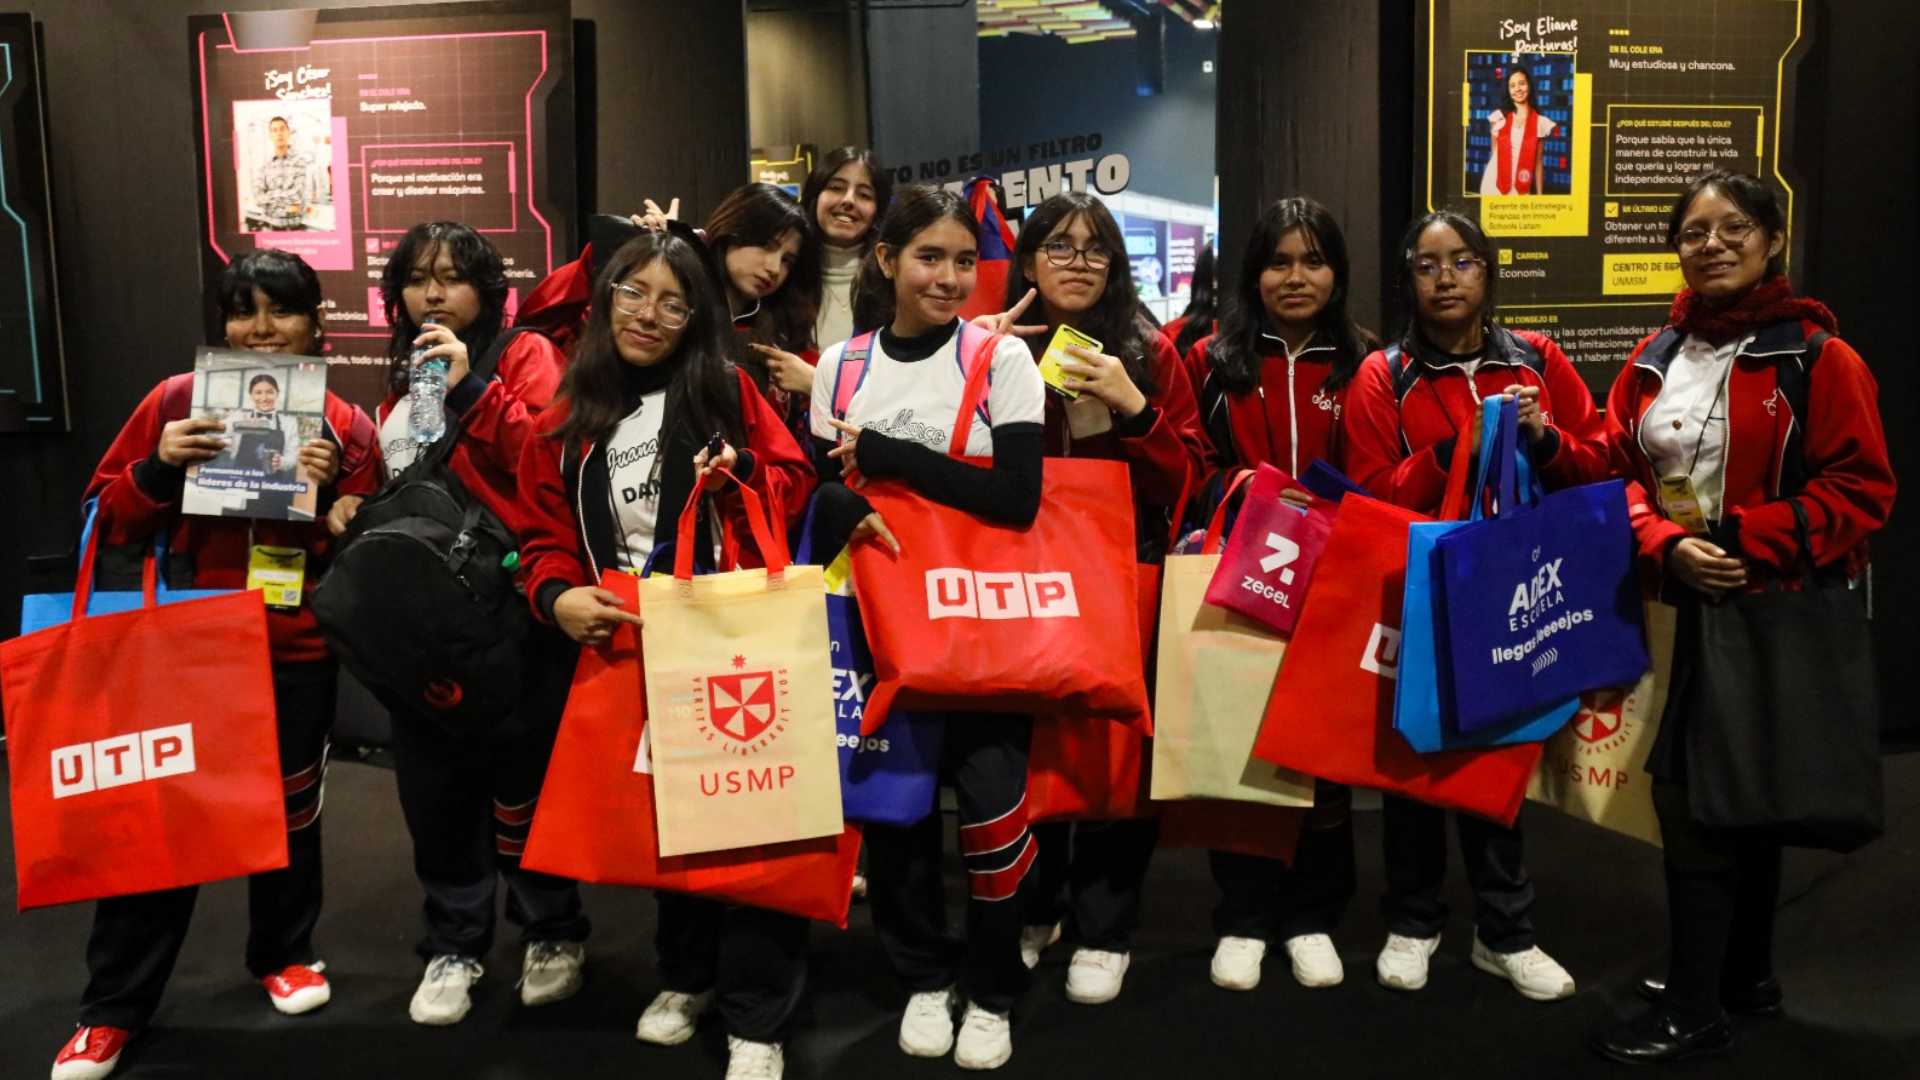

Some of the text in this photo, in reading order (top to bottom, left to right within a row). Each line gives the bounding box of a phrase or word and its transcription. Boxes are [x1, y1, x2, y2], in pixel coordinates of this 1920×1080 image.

[1500, 15, 1578, 40] ¡Soy Eliane
[1629, 45, 1648, 54] COLE
[1649, 45, 1663, 54] ERA
[1609, 59, 1735, 72] Muy estudiosa y chancona.
[1615, 134, 1732, 146] Porque sabía que la única
[919, 159, 950, 181] NO
[957, 153, 983, 171] ES
[1028, 132, 1103, 160] FILTRO
[1615, 148, 1738, 158] manera de construir la vida
[1615, 163, 1633, 173] que
[1666, 162, 1672, 172] y
[1674, 161, 1700, 173] lograr
[1615, 174, 1683, 186] independencia
[1605, 221, 1642, 231] Obtener
[1644, 223, 1656, 231] un
[1604, 234, 1648, 244] diferente
[1499, 268, 1546, 278] Economía
[1612, 262, 1649, 272] CENTRO
[1651, 262, 1663, 271] DE
[1563, 328, 1575, 337] las
[1577, 326, 1645, 338] oportunidades
[1563, 341, 1576, 350] las
[1584, 352, 1608, 362] haber
[607, 438, 659, 480] Juana
[1508, 557, 1563, 616] ADEX
[933, 574, 1070, 613] UTP
[1508, 590, 1564, 632] ESCUELA
[832, 666, 873, 703] EX
[836, 733, 890, 753] eejos
[57, 731, 187, 790] UTP
[700, 765, 795, 797] USMP
